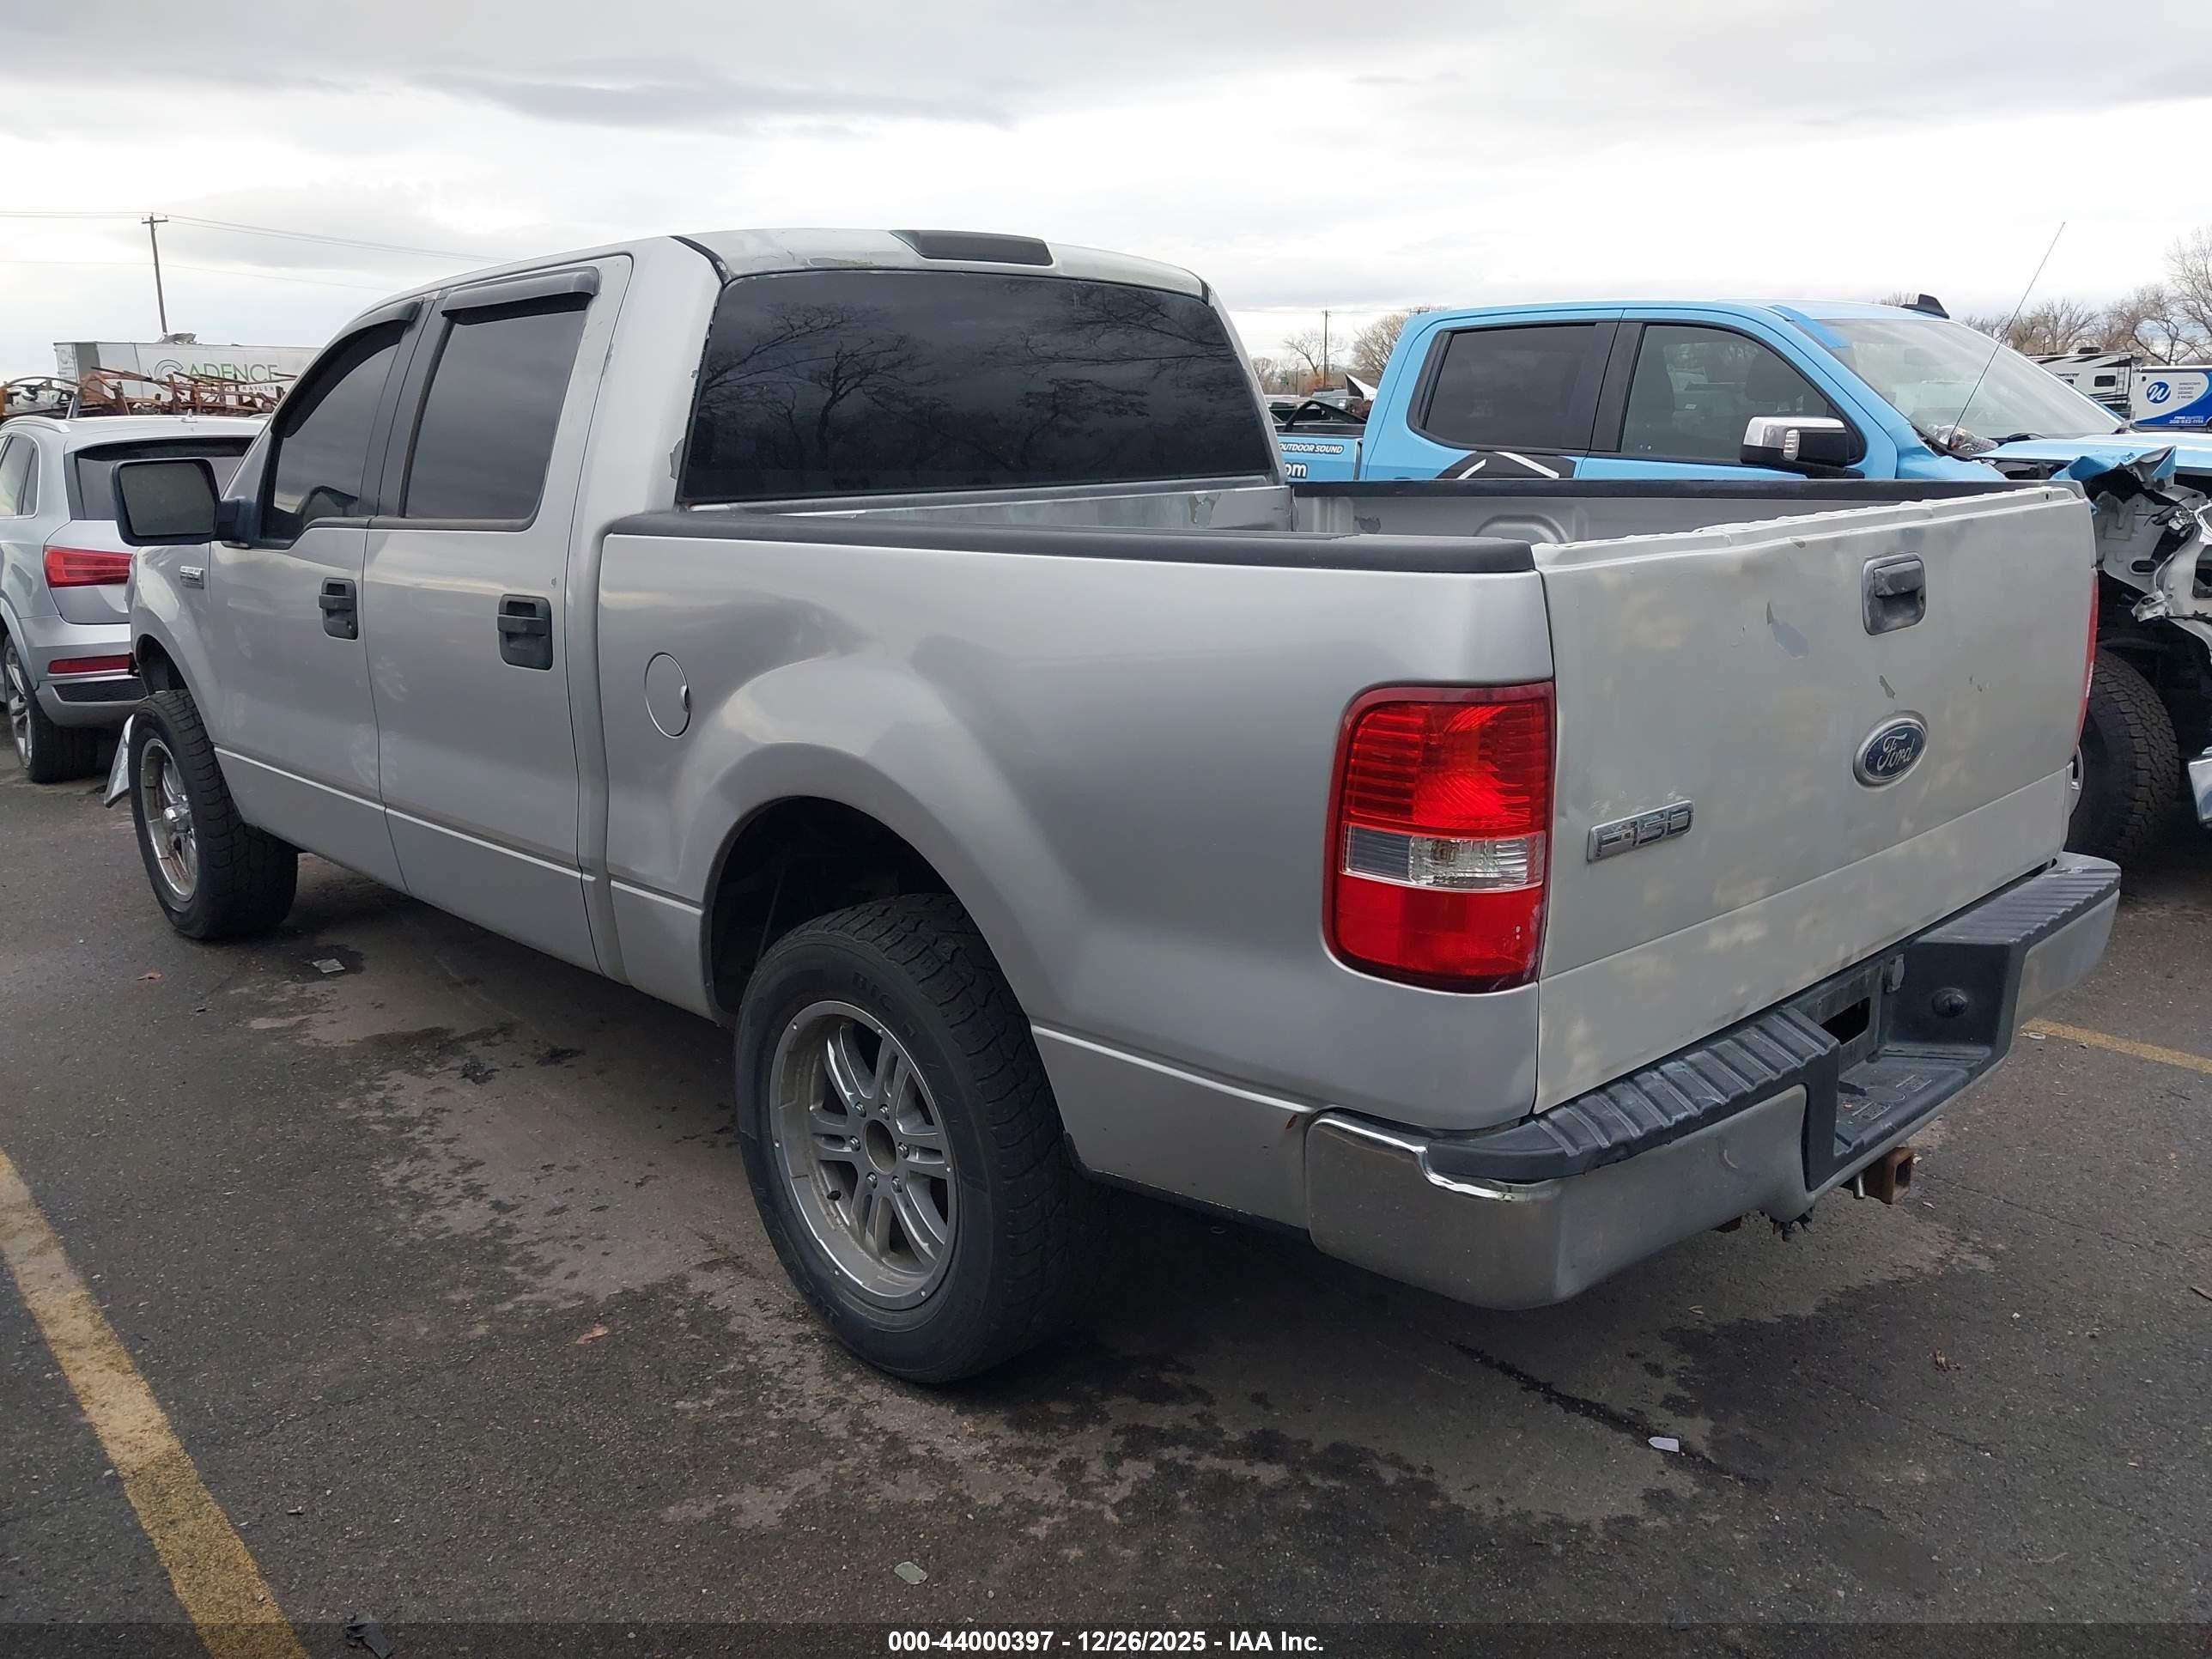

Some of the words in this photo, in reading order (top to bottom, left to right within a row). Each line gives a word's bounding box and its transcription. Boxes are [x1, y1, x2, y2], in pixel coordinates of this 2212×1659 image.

[155, 359, 277, 384] CADENCE
[1279, 442, 1315, 453] OUTDOOR
[1315, 445, 1343, 453] SOUND
[1876, 732, 1915, 772] Ford
